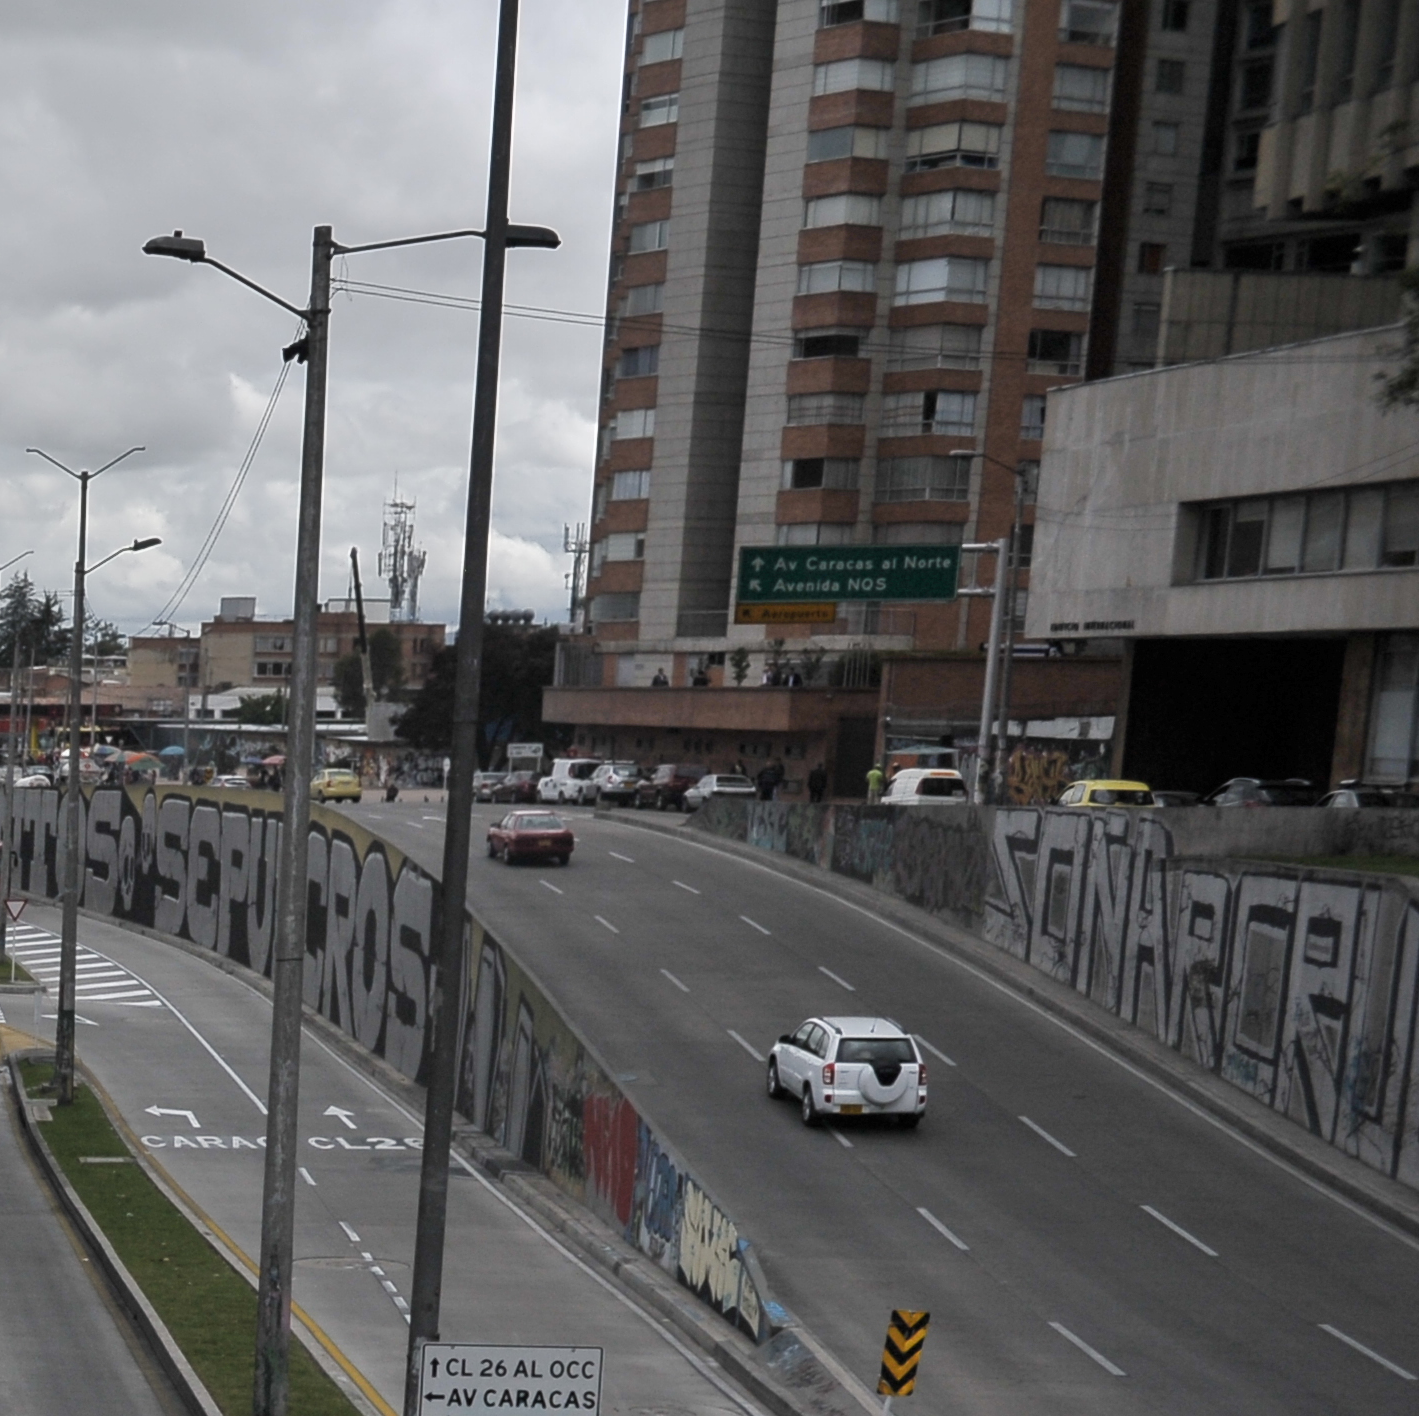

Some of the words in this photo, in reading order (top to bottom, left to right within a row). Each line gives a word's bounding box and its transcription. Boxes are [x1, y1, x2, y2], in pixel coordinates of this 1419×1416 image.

[774, 558, 797, 571] Av
[806, 557, 873, 570] Caracas
[882, 556, 896, 569] al
[904, 555, 951, 569] Norte
[773, 578, 840, 592] Avenida
[446, 1358, 473, 1377] CL
[479, 1358, 507, 1378] 26
[513, 1360, 543, 1379] AL
[549, 1360, 595, 1380] OCC
[447, 1388, 477, 1407] AV
[483, 1389, 596, 1410] CARACAS
